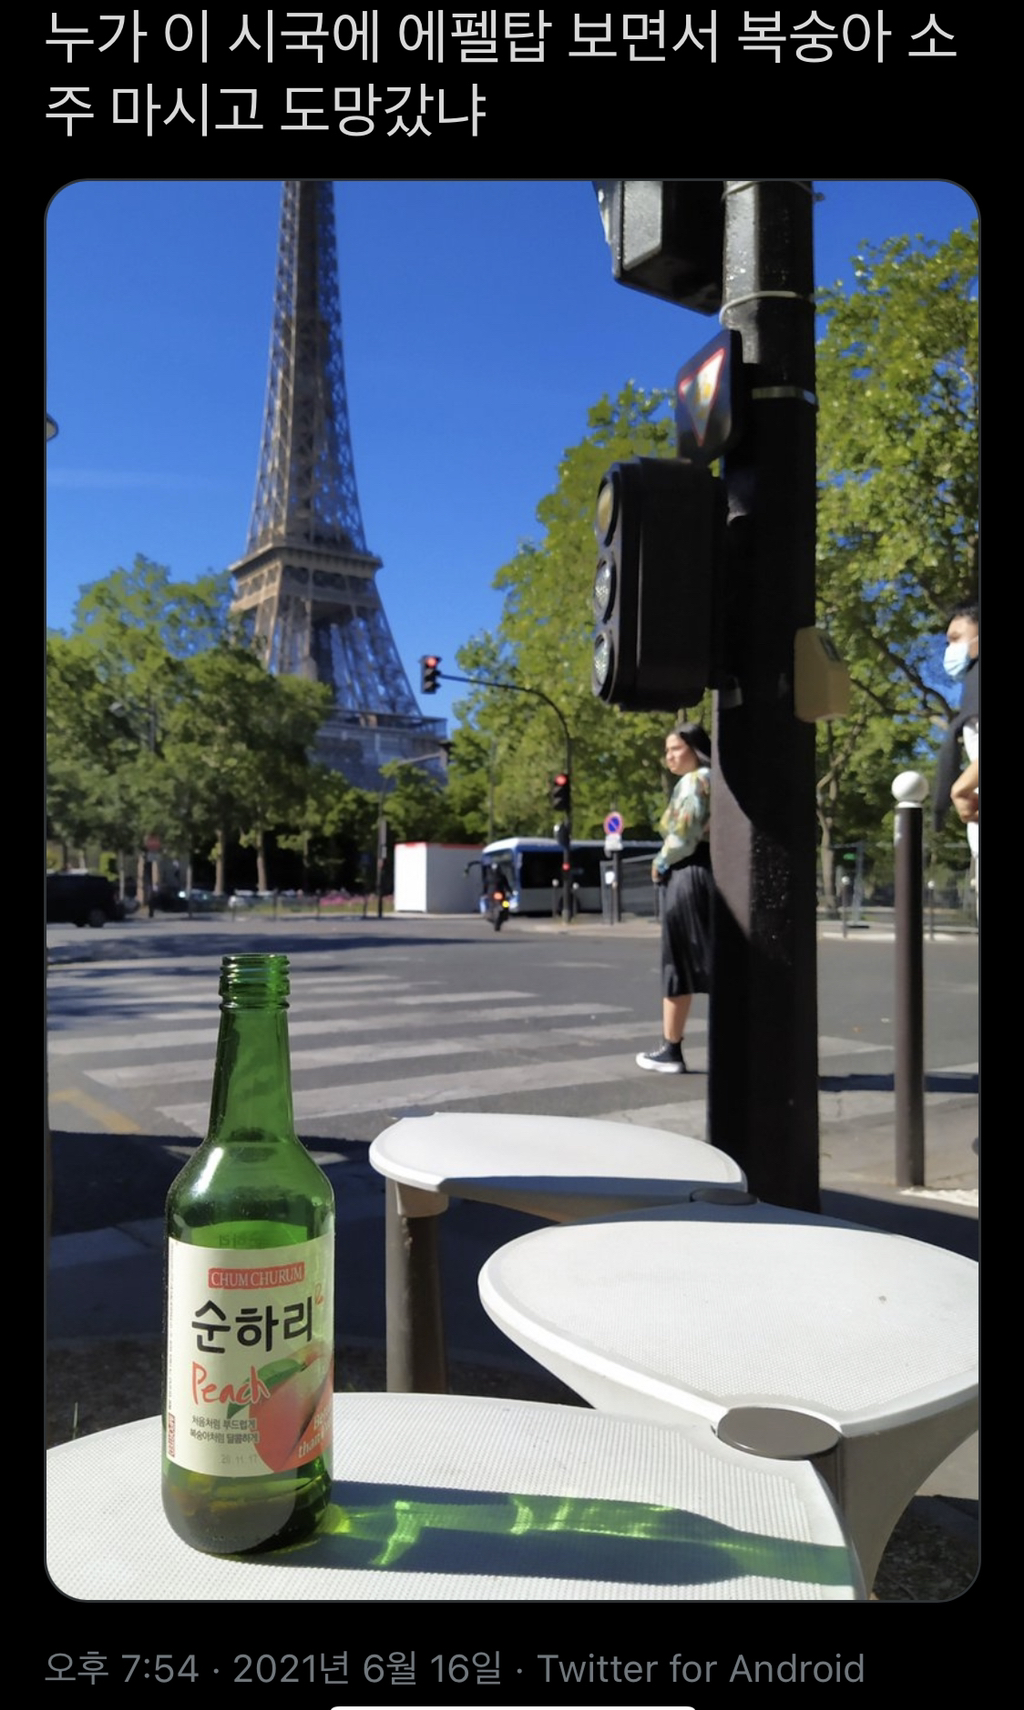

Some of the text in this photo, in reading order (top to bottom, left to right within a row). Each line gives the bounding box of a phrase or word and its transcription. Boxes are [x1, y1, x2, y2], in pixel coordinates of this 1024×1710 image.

[211, 1266, 302, 1287] CHUM CHURUM
[191, 1297, 313, 1354] 순하리
[192, 1361, 271, 1406] Peach
